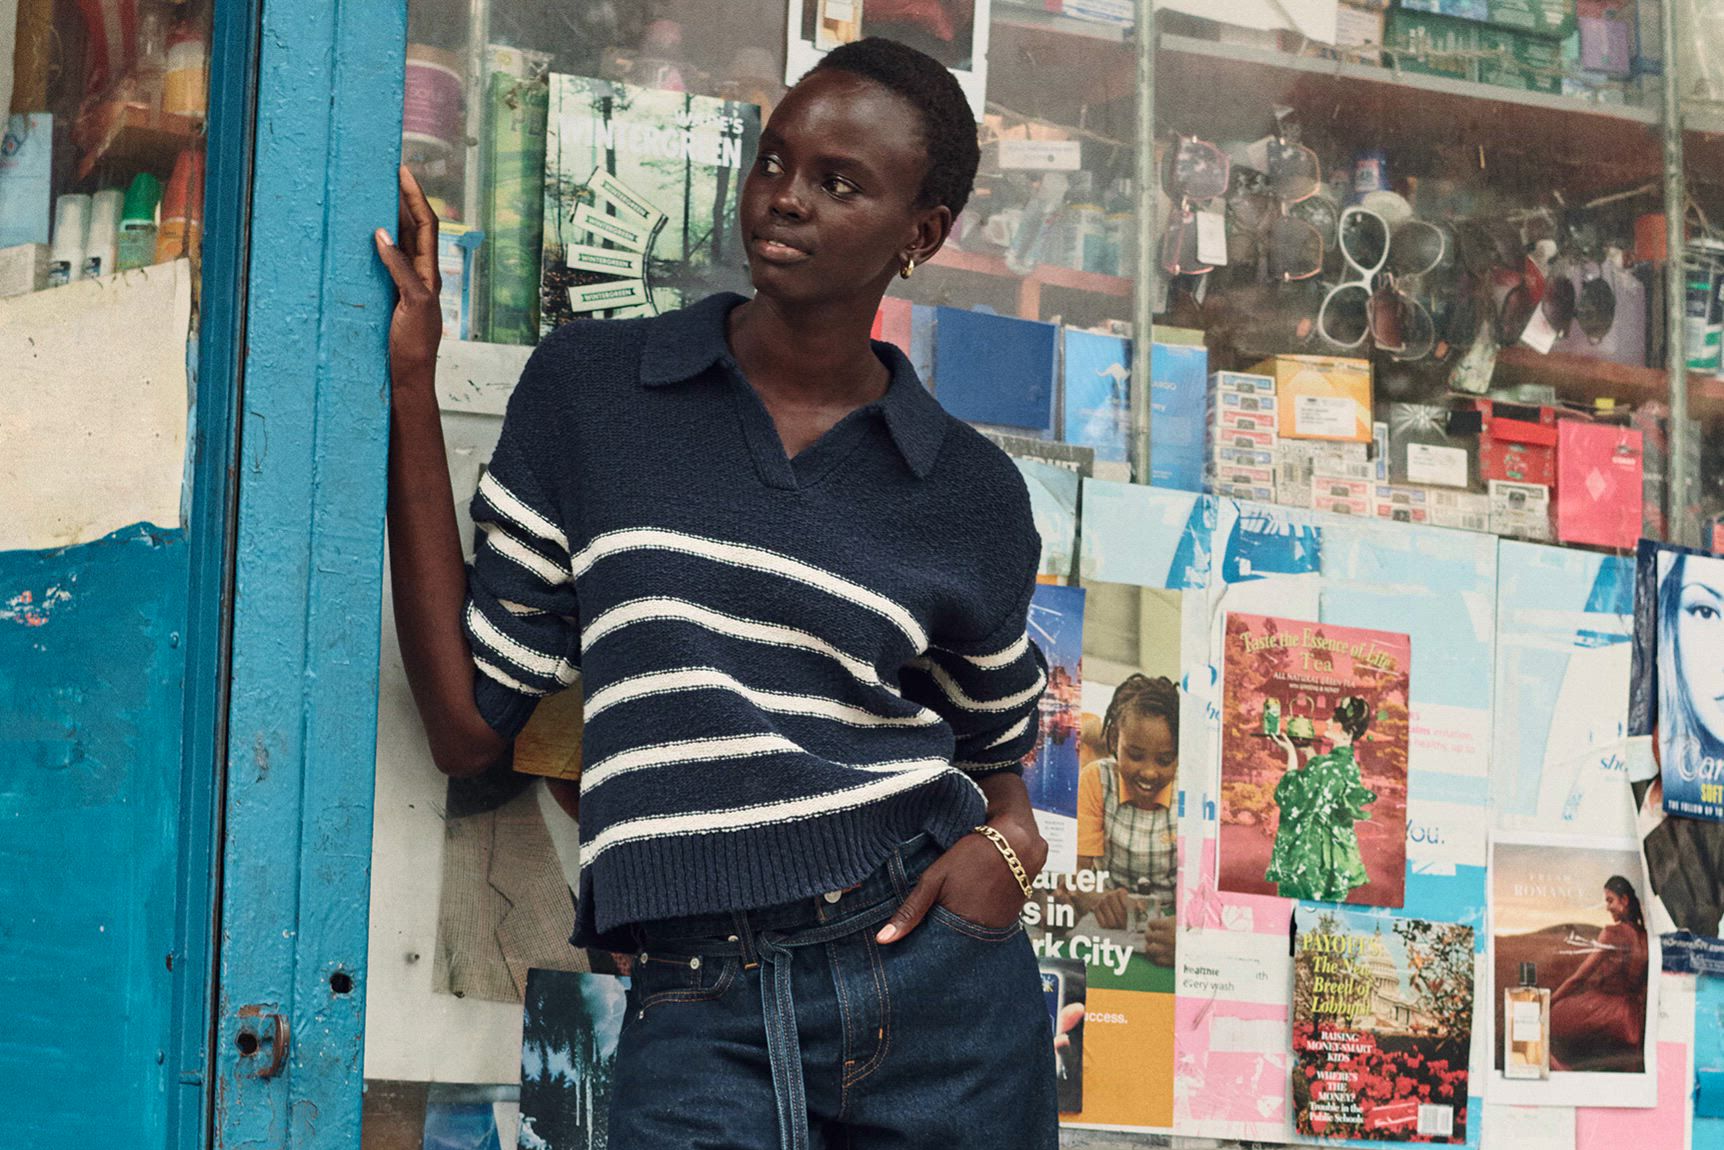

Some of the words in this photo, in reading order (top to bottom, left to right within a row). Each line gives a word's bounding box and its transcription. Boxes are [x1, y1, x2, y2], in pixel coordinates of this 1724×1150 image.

[1240, 631, 1277, 653] Taste
[1279, 632, 1300, 649] the
[1302, 627, 1349, 655] Essence
[1351, 641, 1366, 657] of
[1366, 643, 1391, 670] Life
[1300, 652, 1334, 673] Tea
[1681, 802, 1703, 815] FOLLOW
[1032, 868, 1110, 893] arter
[1047, 896, 1075, 928] in
[1069, 934, 1134, 976] City
[1312, 956, 1338, 974] The
[1210, 980, 1235, 992] wash
[1313, 976, 1355, 994] Breed
[1357, 980, 1372, 998] of
[1084, 1010, 1128, 1025] uccess.
[1321, 1031, 1360, 1043] RAISING
[1327, 1052, 1351, 1063] KIDS
[1327, 1081, 1348, 1092] THE
[1309, 1101, 1340, 1112] Trouble
